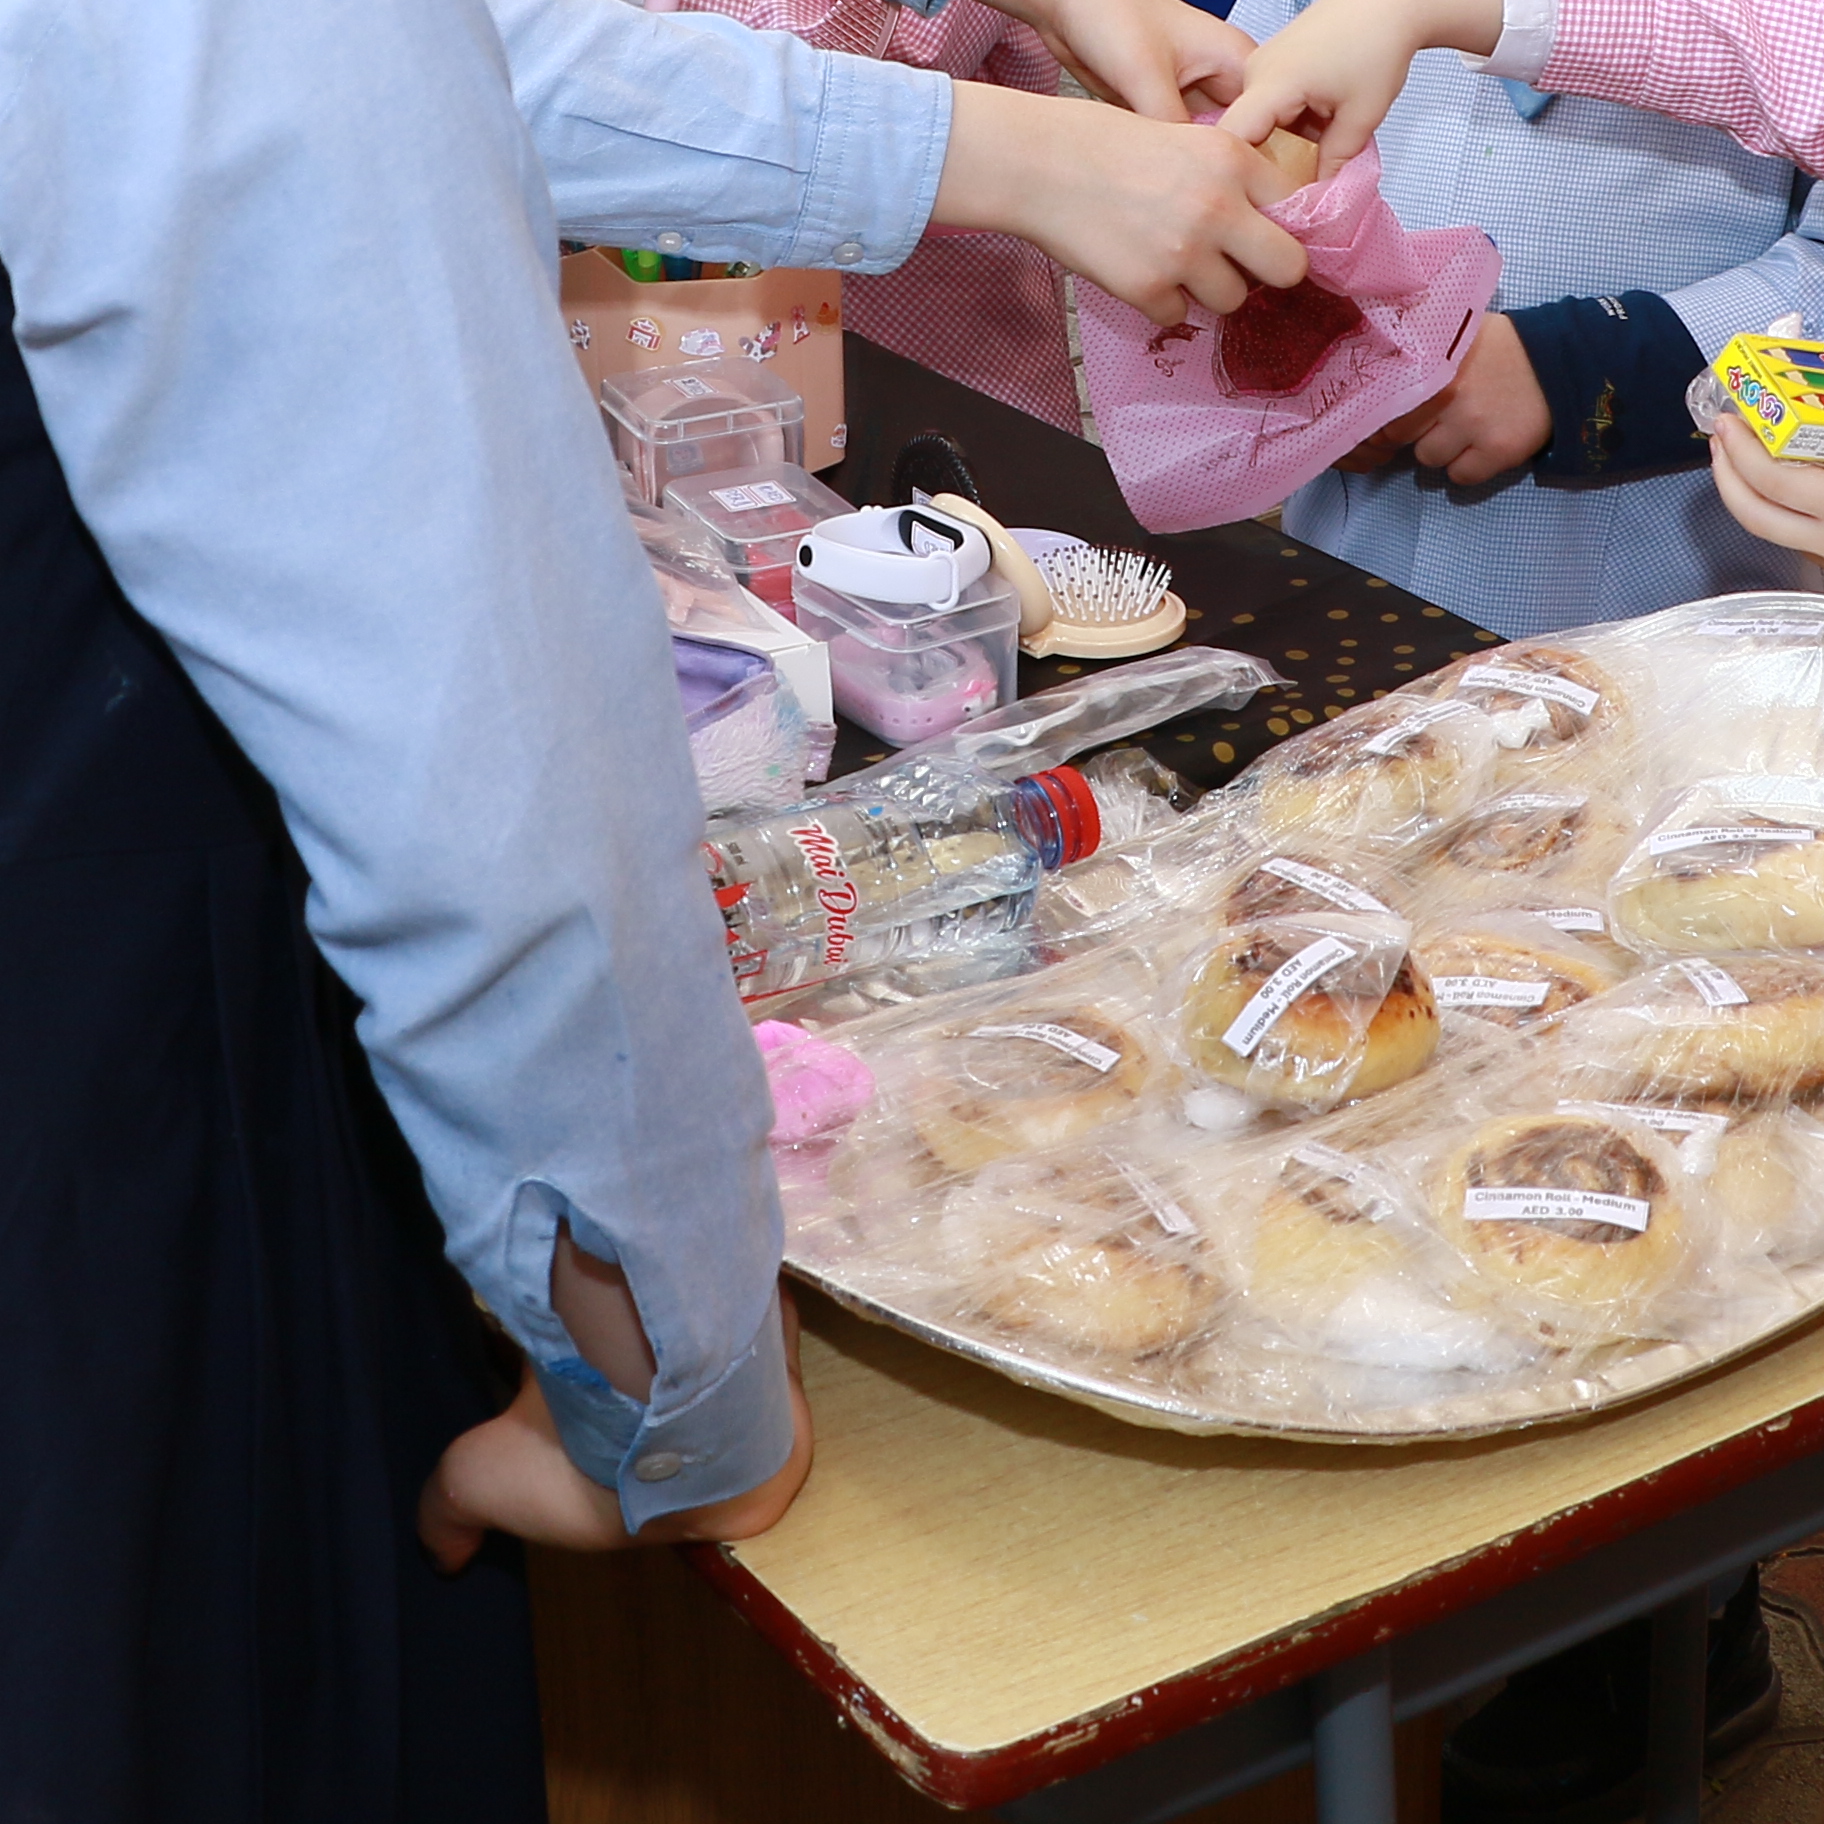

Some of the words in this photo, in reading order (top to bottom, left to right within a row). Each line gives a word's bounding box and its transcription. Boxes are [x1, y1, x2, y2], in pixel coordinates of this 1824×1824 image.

[1657, 829, 1719, 842] Cinnamon
[789, 823, 847, 882] Mai
[817, 881, 858, 966] Dubai
[1281, 958, 1304, 978] AED
[1300, 947, 1346, 980] Cinnamon
[1259, 977, 1283, 1000] 3.00
[1280, 980, 1304, 1003] Roll
[1241, 1002, 1280, 1046] Medium
[1475, 1190, 1542, 1203] Cinnamon
[1545, 1191, 1572, 1203] Roll
[1582, 1194, 1638, 1213] Medium
[1521, 1205, 1550, 1216] AED
[1555, 1206, 1584, 1217] 3.00
